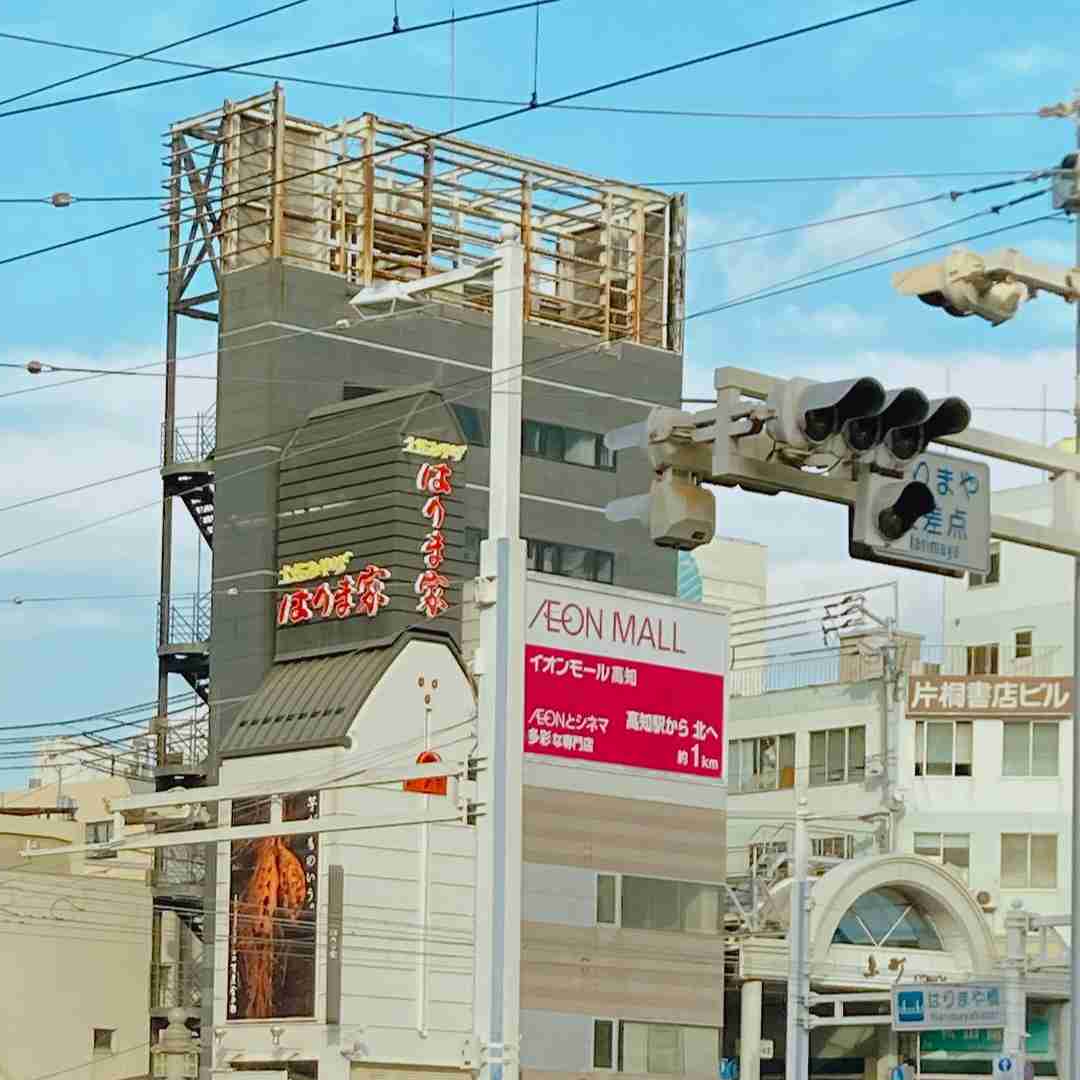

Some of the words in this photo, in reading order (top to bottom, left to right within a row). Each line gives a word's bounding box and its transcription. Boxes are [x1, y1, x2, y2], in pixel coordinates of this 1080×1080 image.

[912, 461, 980, 500] りまや
[922, 506, 969, 541] 差点
[612, 611, 686, 655] MALL
[529, 653, 638, 688] イオンモール高知
